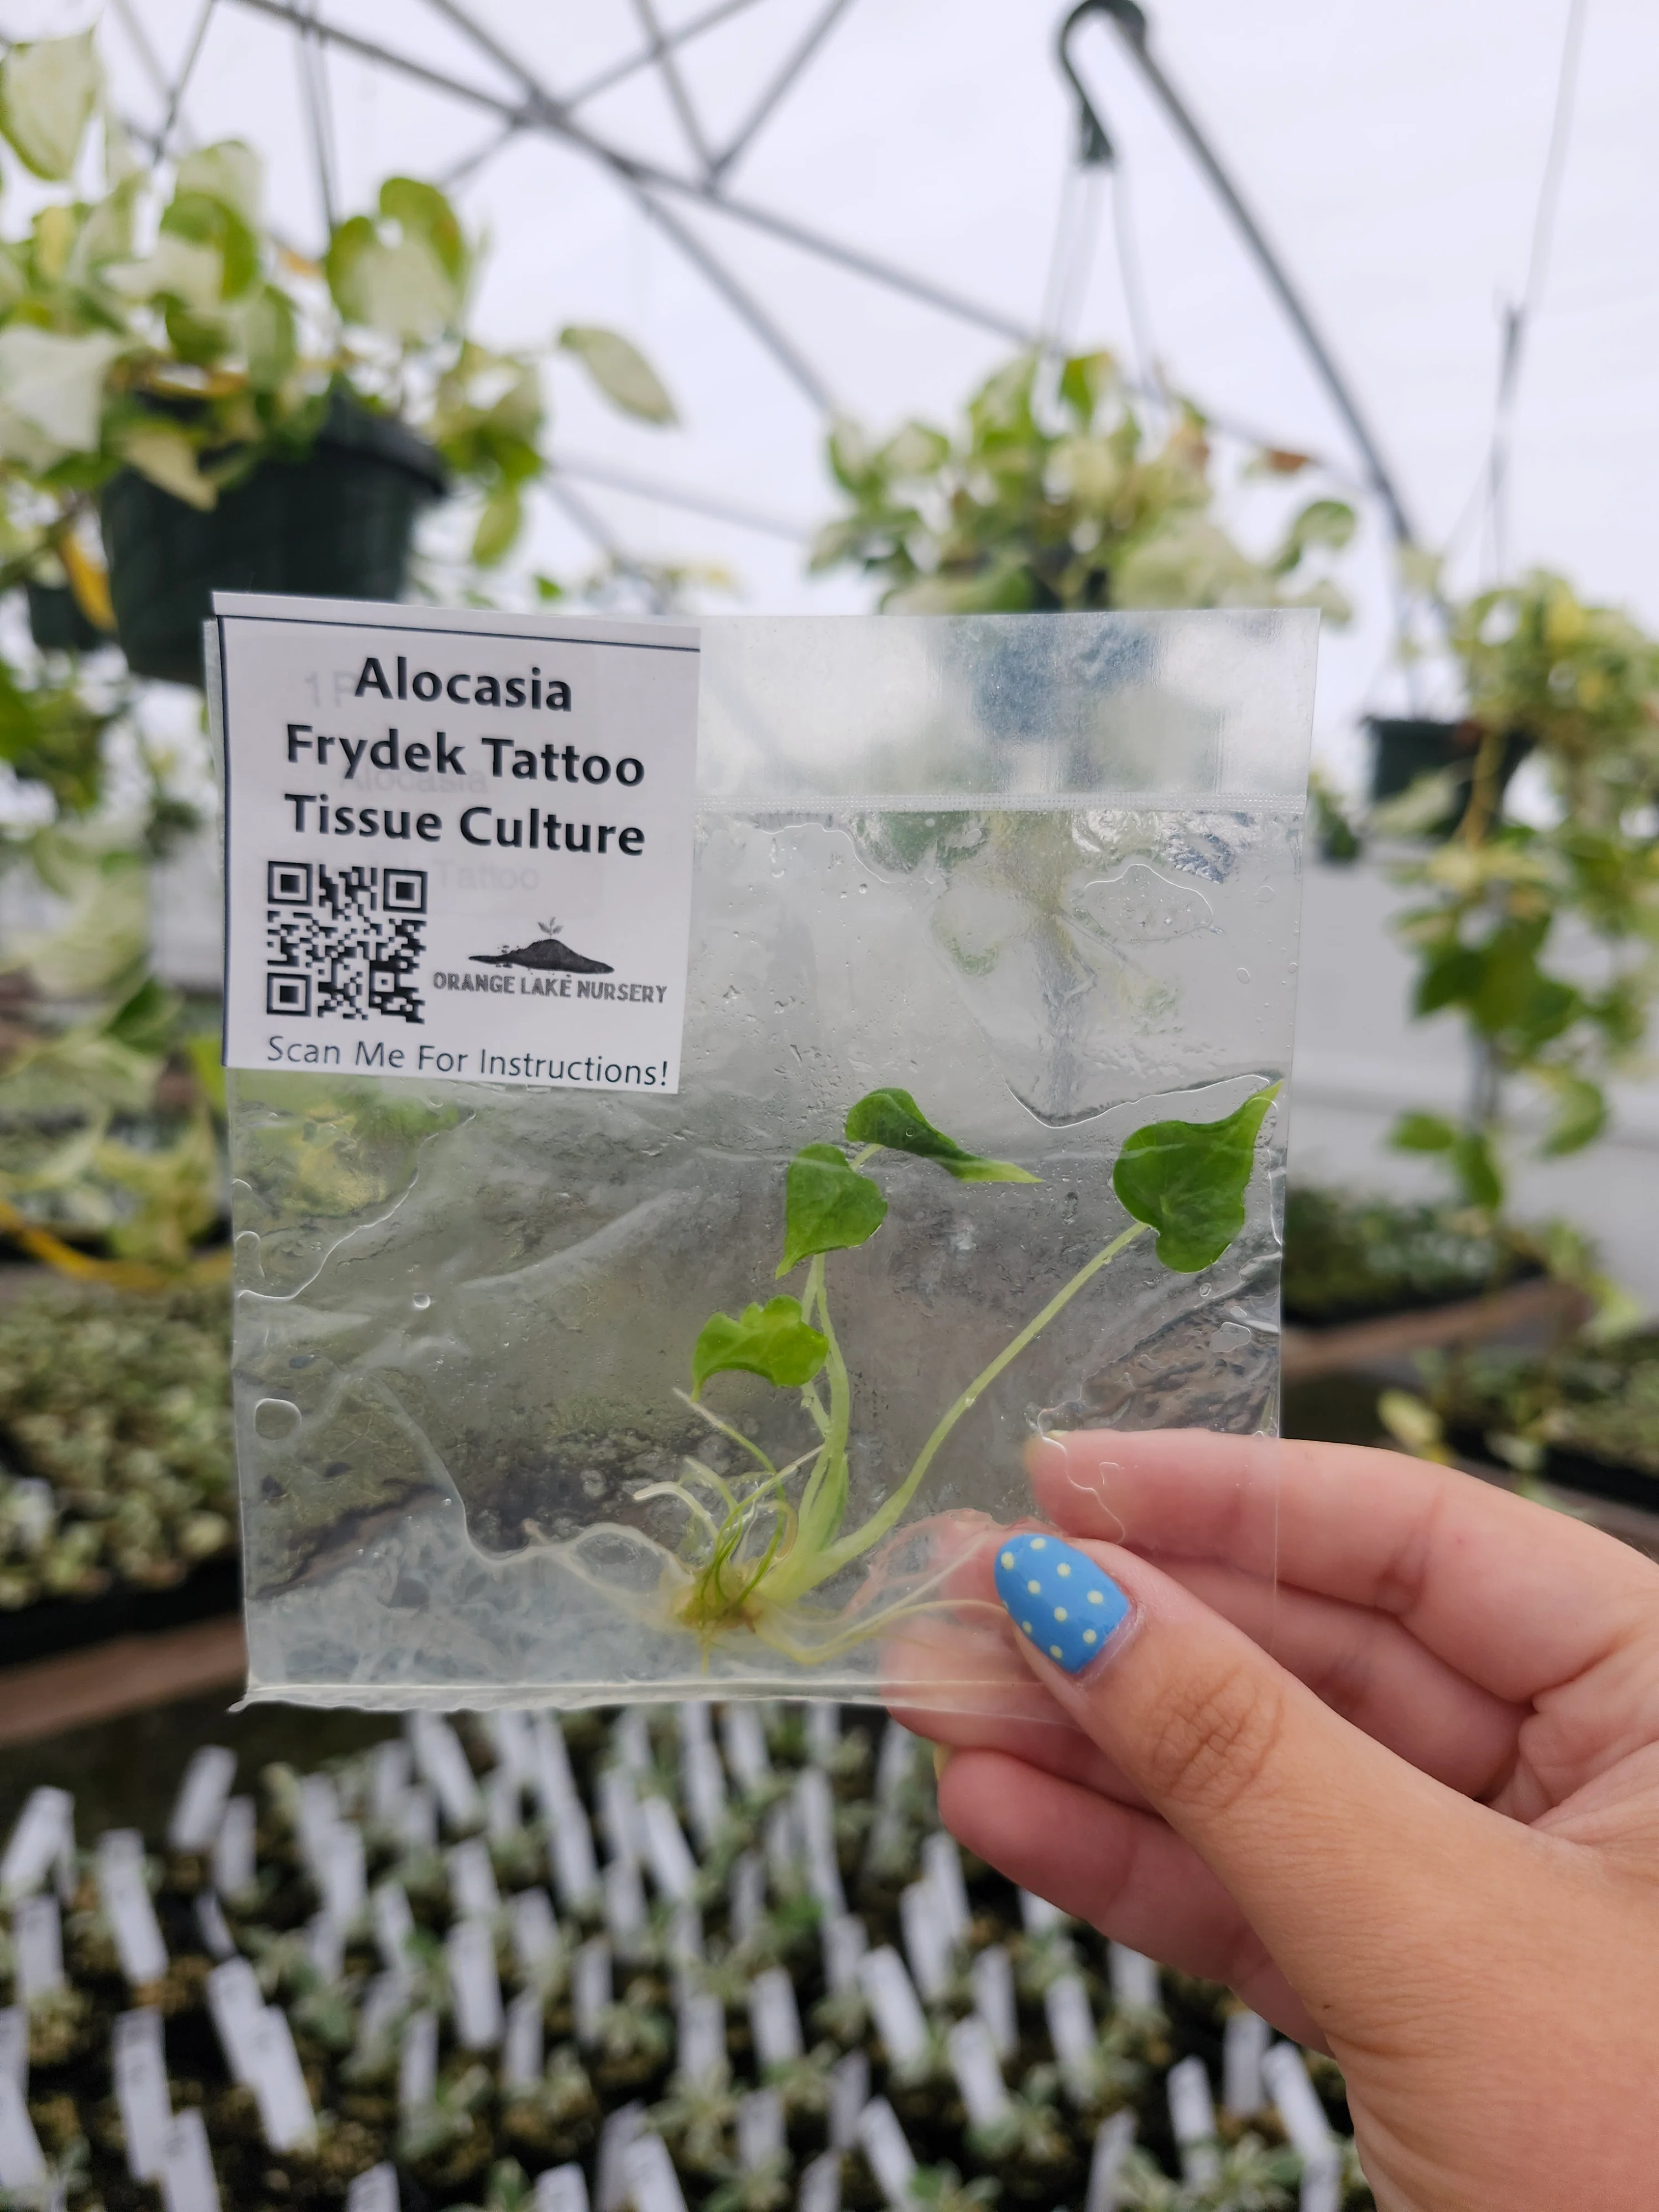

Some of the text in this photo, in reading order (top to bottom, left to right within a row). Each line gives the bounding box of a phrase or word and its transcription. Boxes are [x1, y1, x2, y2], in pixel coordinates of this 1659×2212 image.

[354, 655, 572, 713] Alocasia
[286, 723, 645, 787] Frydek Tattoo
[283, 792, 645, 857] Tissue Culture
[433, 972, 667, 1004] ORANGE LAKE NURSERY
[267, 1035, 668, 1086] Scan Me For Instructions!
